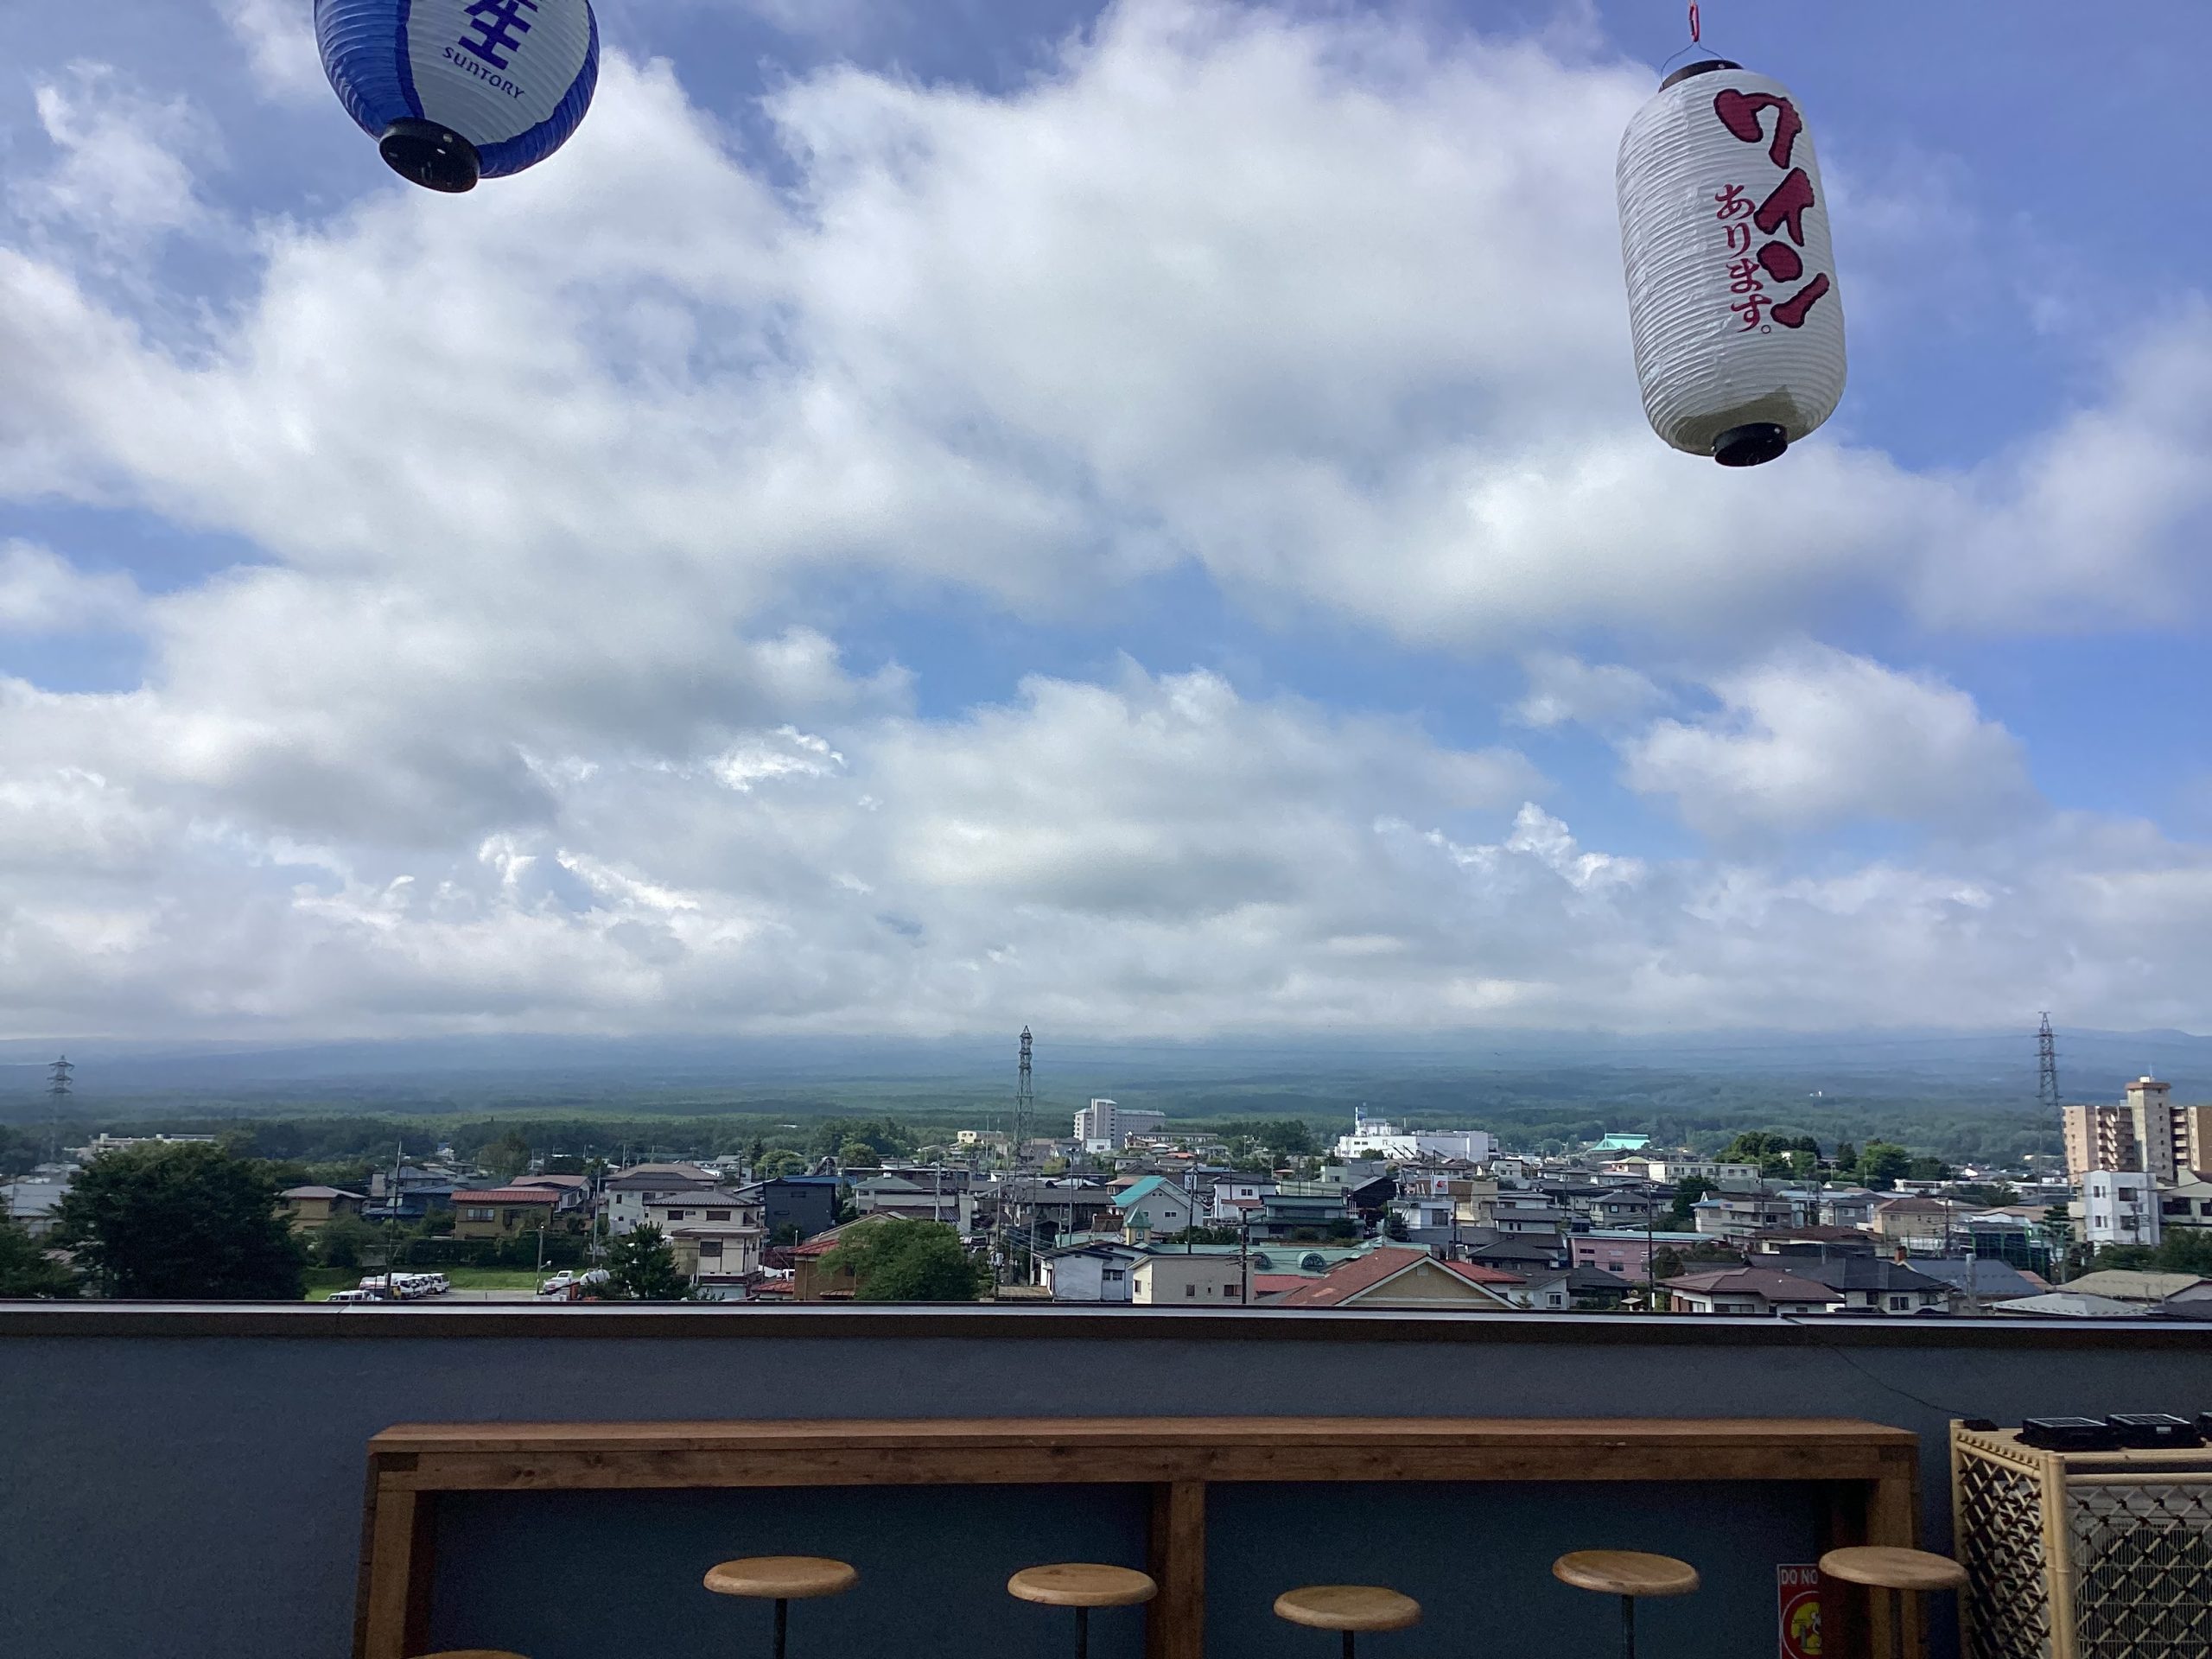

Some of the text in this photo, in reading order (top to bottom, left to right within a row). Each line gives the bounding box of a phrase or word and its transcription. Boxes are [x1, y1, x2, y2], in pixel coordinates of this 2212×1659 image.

[442, 47, 525, 99] SUNTORY
[1714, 88, 1829, 328] ワイン
[1781, 1569, 1819, 1585] DO NO
